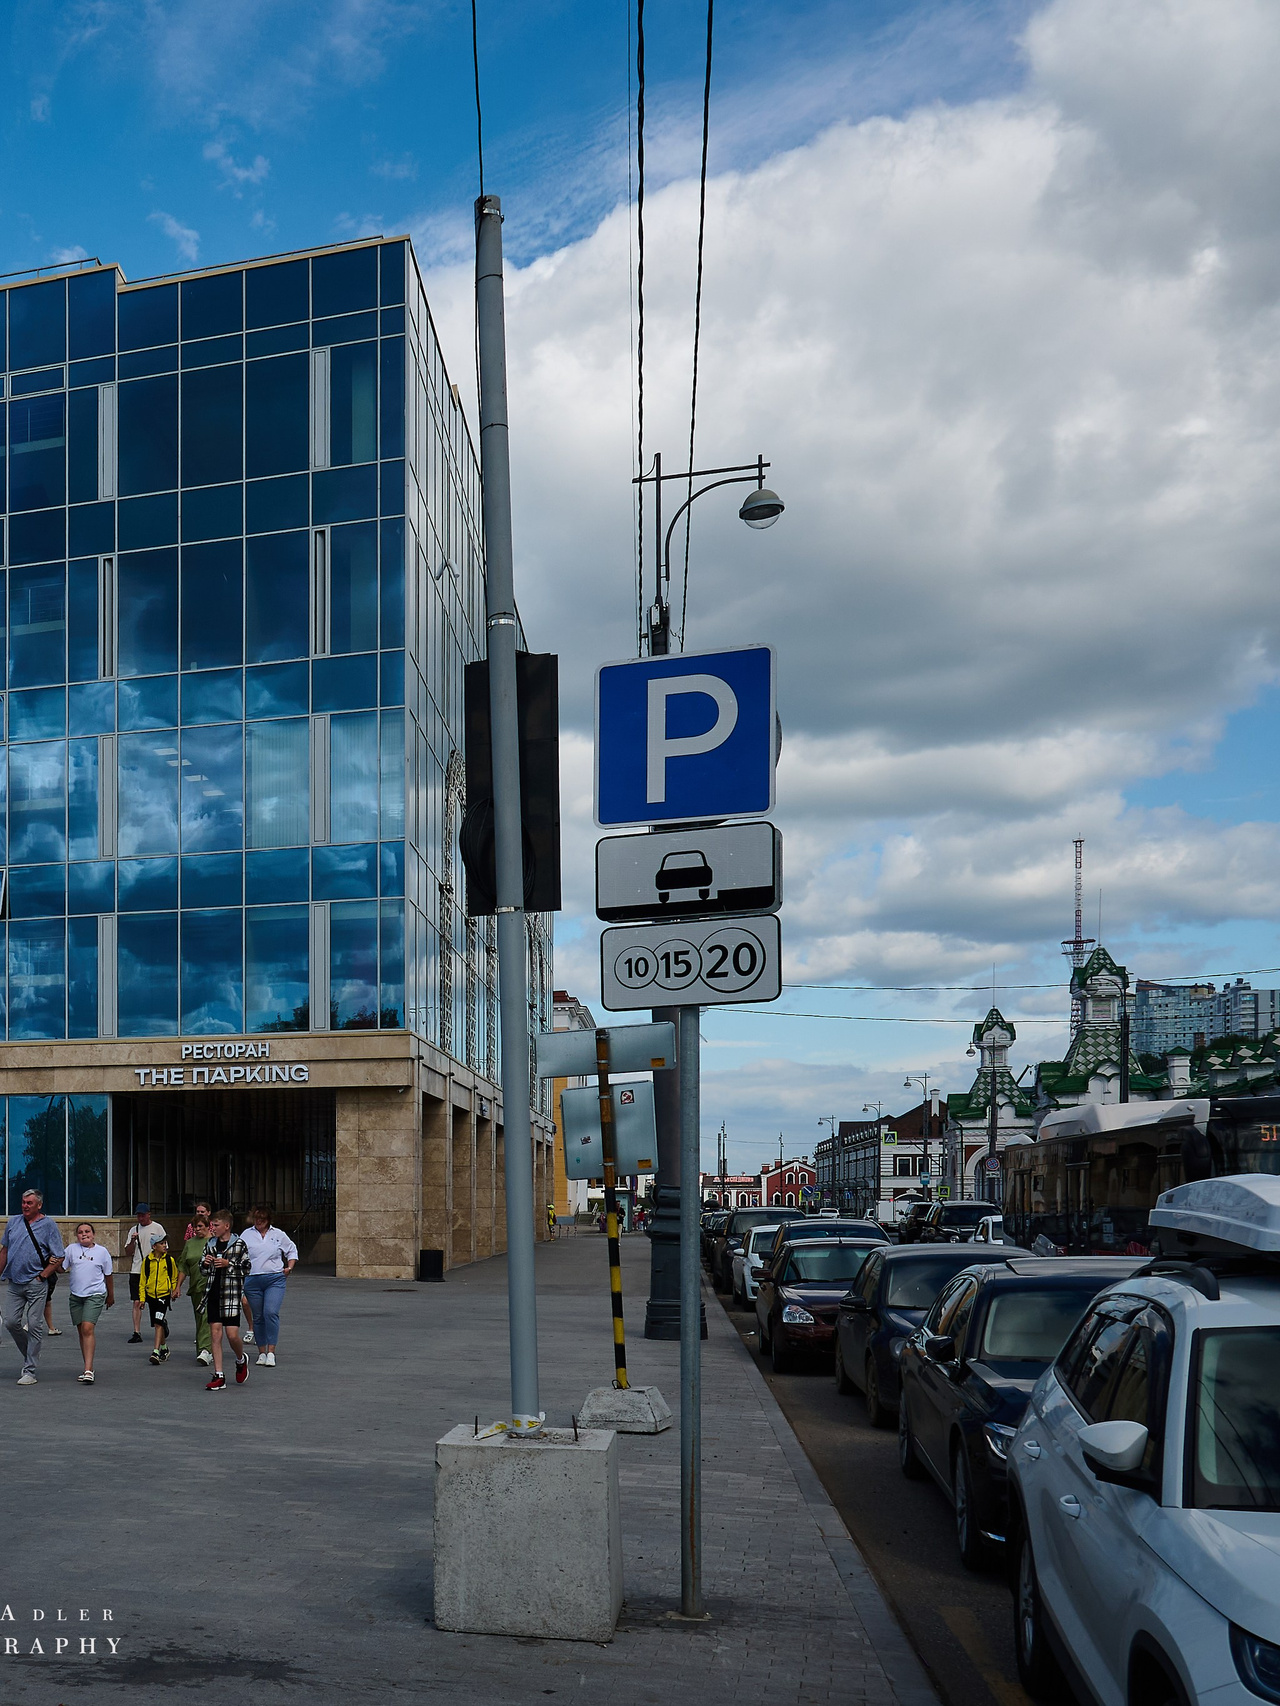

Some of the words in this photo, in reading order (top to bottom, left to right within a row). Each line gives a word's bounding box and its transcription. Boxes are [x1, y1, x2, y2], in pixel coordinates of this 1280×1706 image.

[647, 674, 738, 804] P
[624, 957, 649, 978] 10
[660, 950, 692, 979] 15
[706, 943, 757, 979] 20
[181, 1042, 270, 1060] РЕСТОРАН
[134, 1068, 184, 1086] THE
